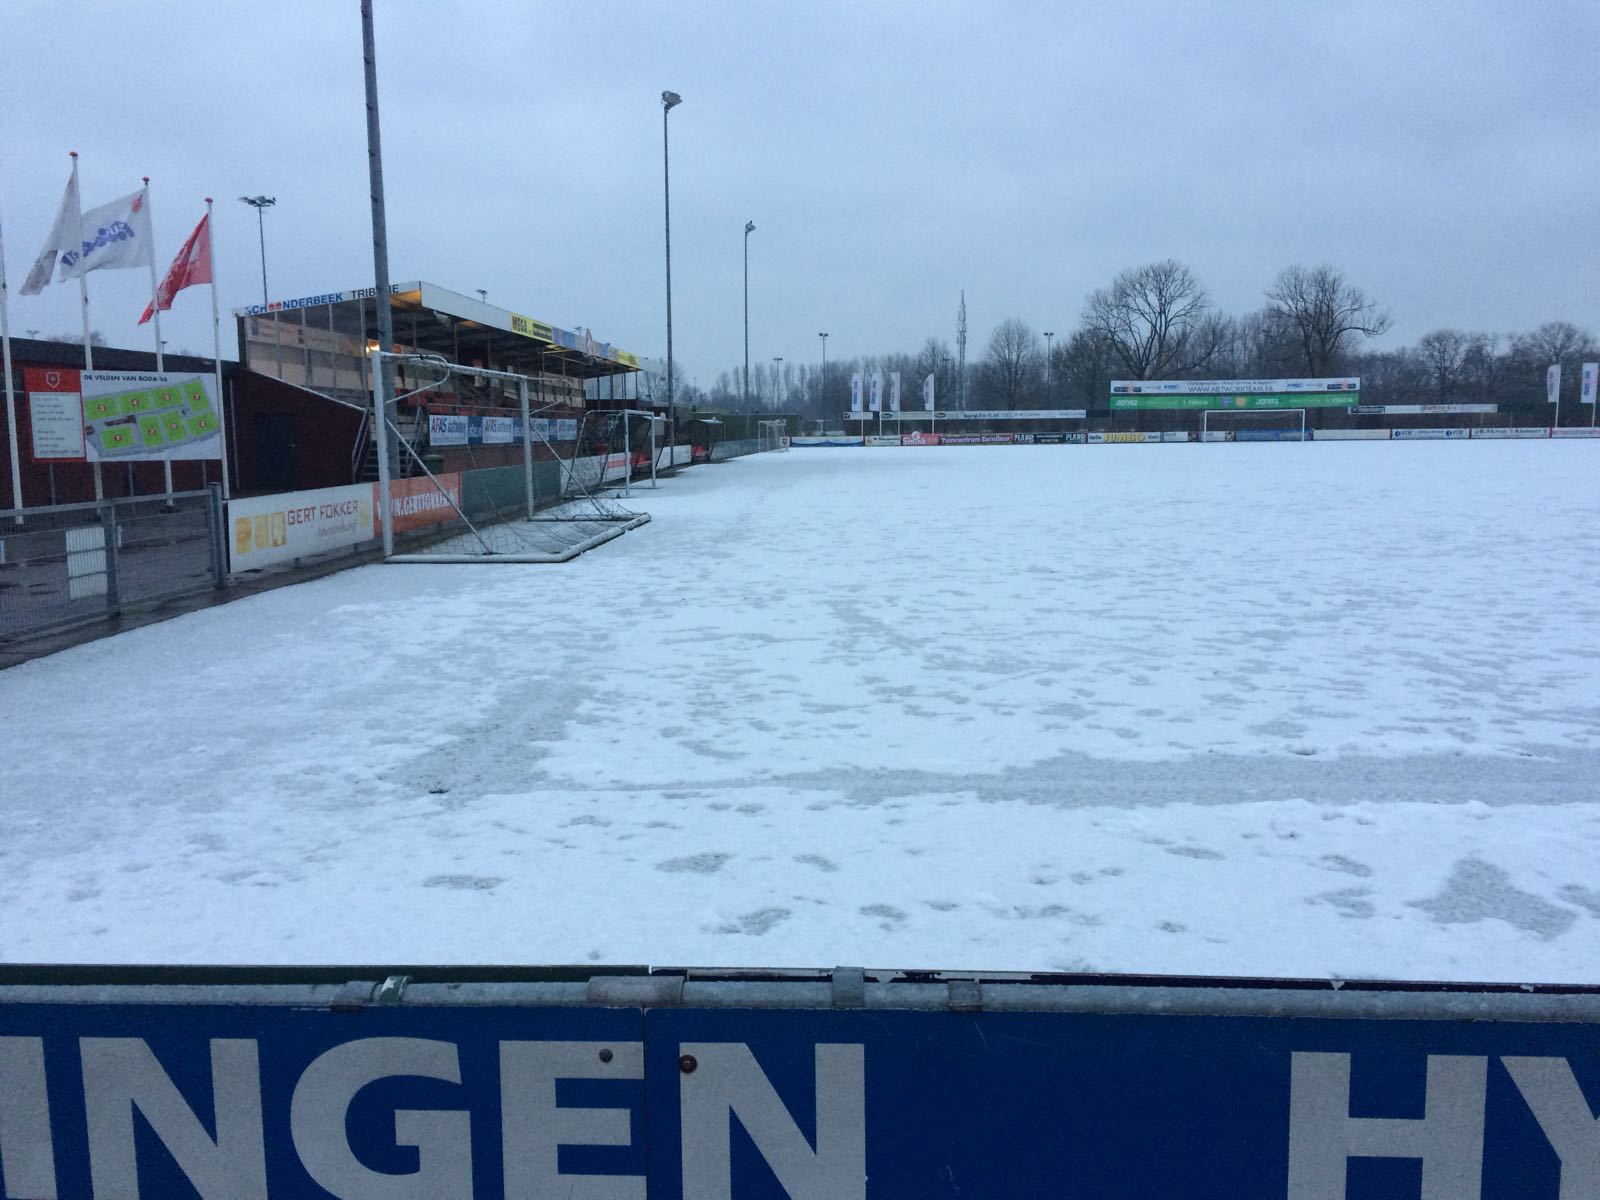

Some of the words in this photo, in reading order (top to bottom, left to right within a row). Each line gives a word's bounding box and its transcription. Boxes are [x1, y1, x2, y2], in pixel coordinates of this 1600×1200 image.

[351, 284, 399, 299] TRIBE
[902, 437, 926, 445] Smink
[287, 506, 316, 525] GERT
[320, 500, 358, 520] FOKKER
